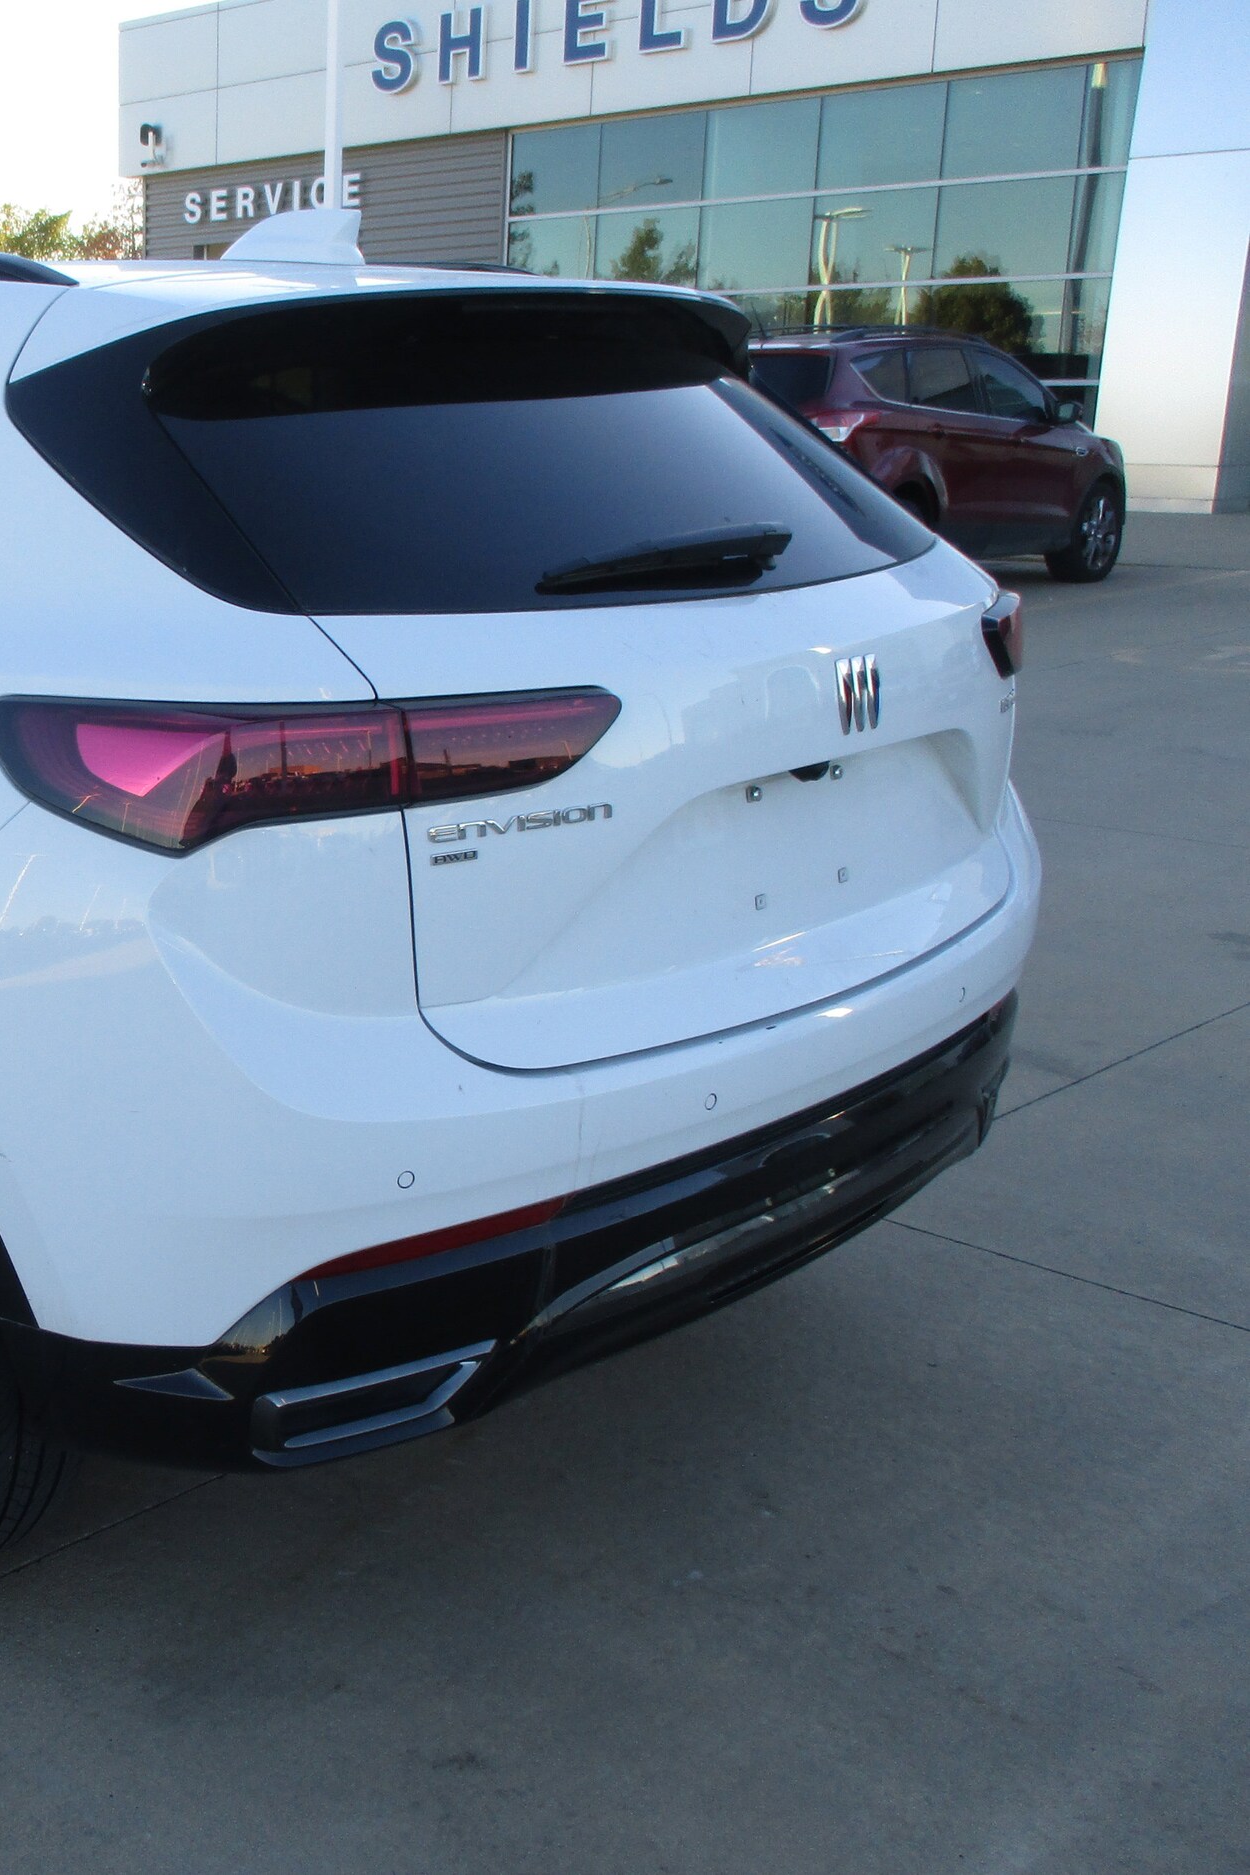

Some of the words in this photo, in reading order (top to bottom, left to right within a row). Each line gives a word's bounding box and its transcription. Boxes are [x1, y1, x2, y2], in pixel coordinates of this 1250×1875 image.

[184, 172, 362, 224] SERVICE
[427, 802, 613, 843] ENVISION
[432, 849, 478, 866] AWD
